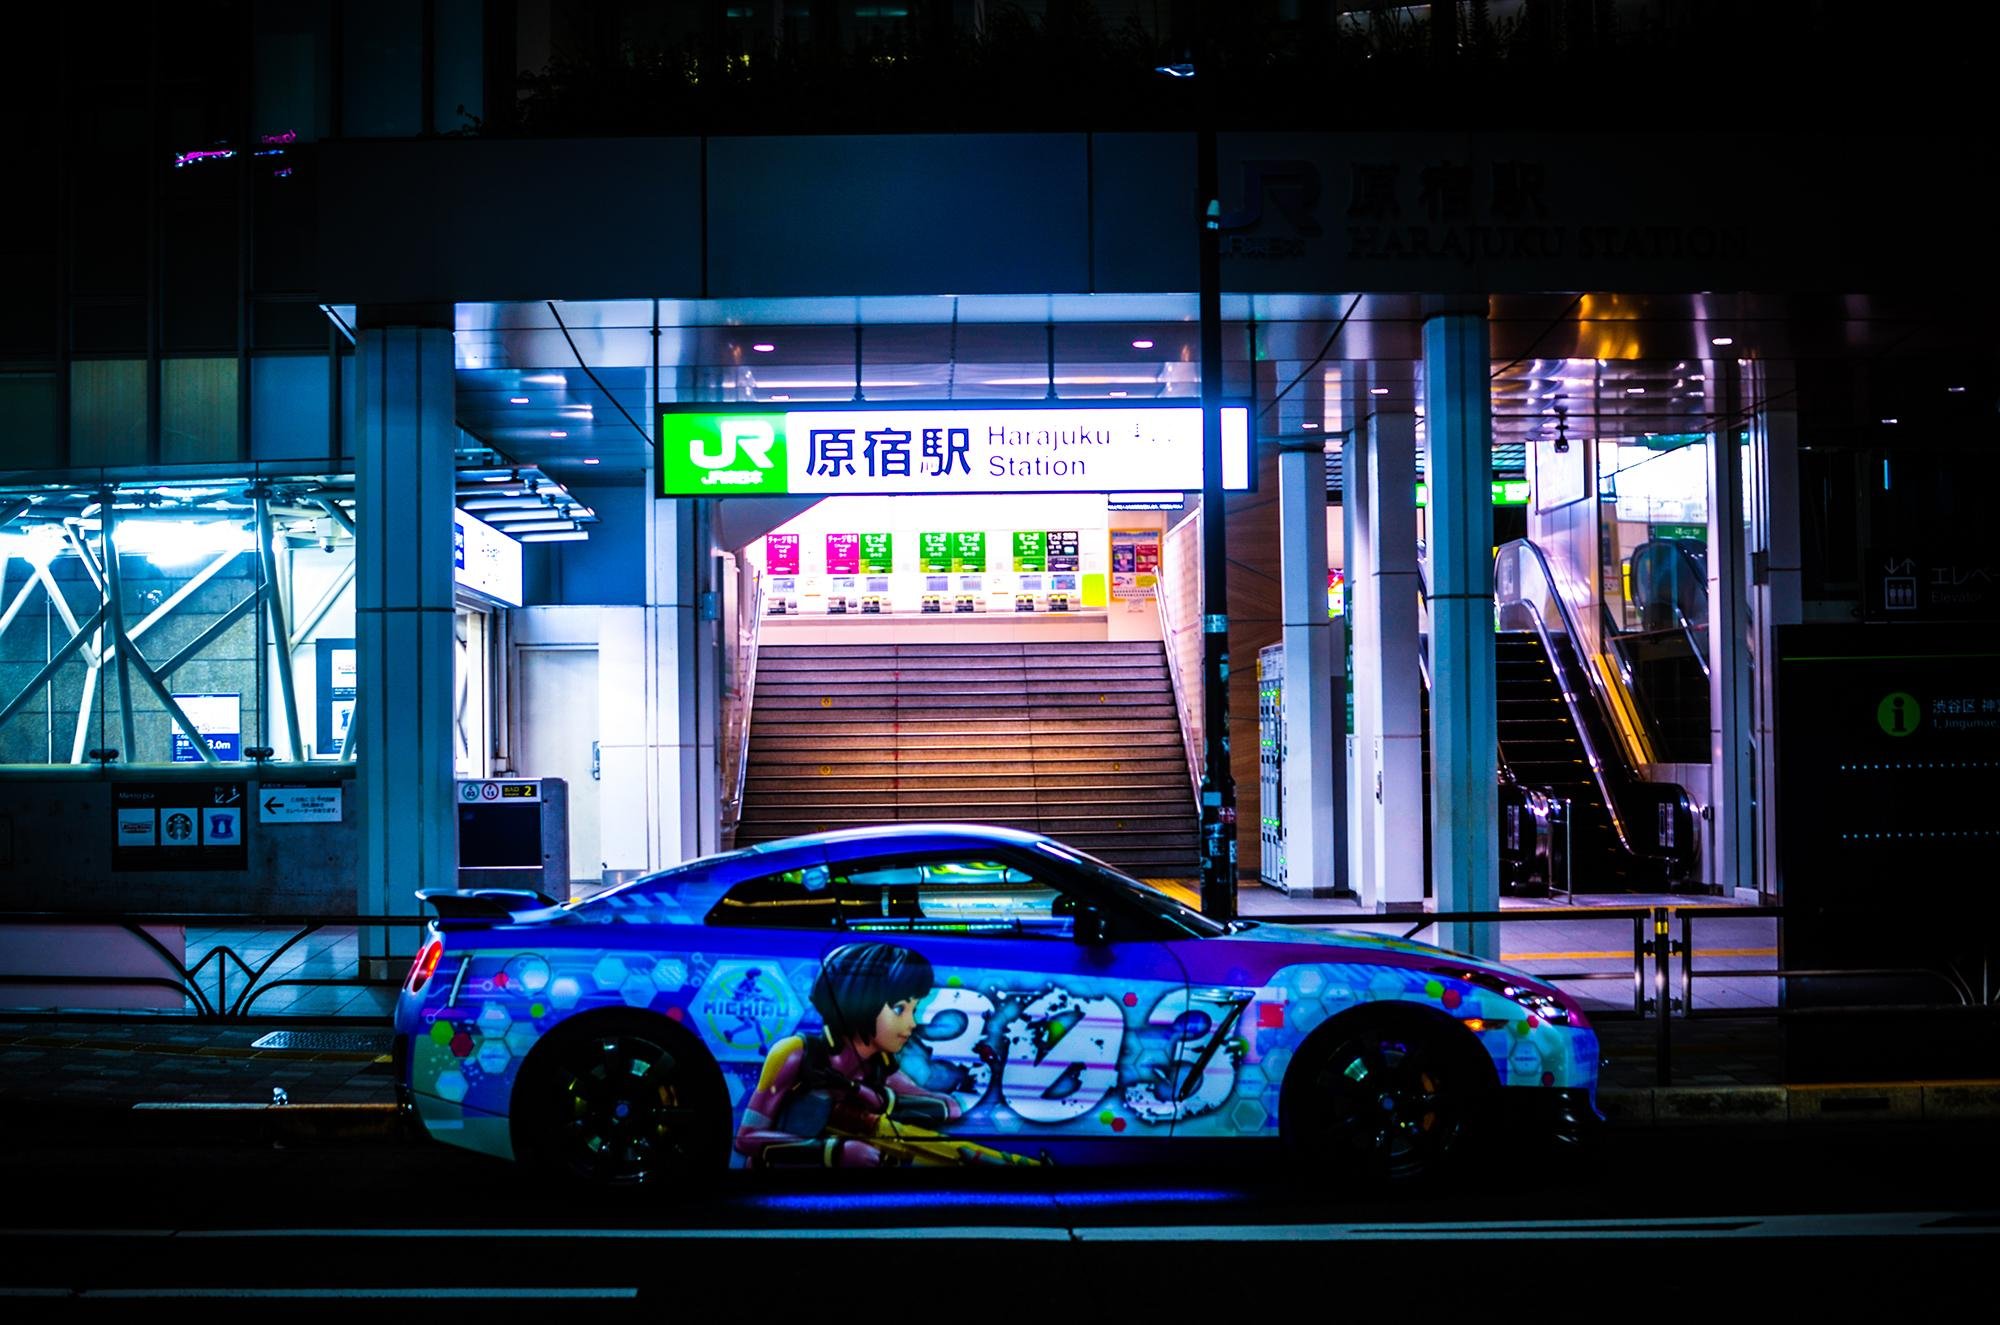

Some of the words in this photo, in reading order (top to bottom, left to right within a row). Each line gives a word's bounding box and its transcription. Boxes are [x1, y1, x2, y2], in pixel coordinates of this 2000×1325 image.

[1344, 226, 1568, 264] HARAJUKU
[1577, 225, 1747, 261] STATION
[689, 419, 776, 469] JR
[805, 427, 971, 477] 原宿駅
[988, 425, 1111, 451] Harajuku
[988, 455, 1086, 477] Station
[524, 785, 531, 797] 2
